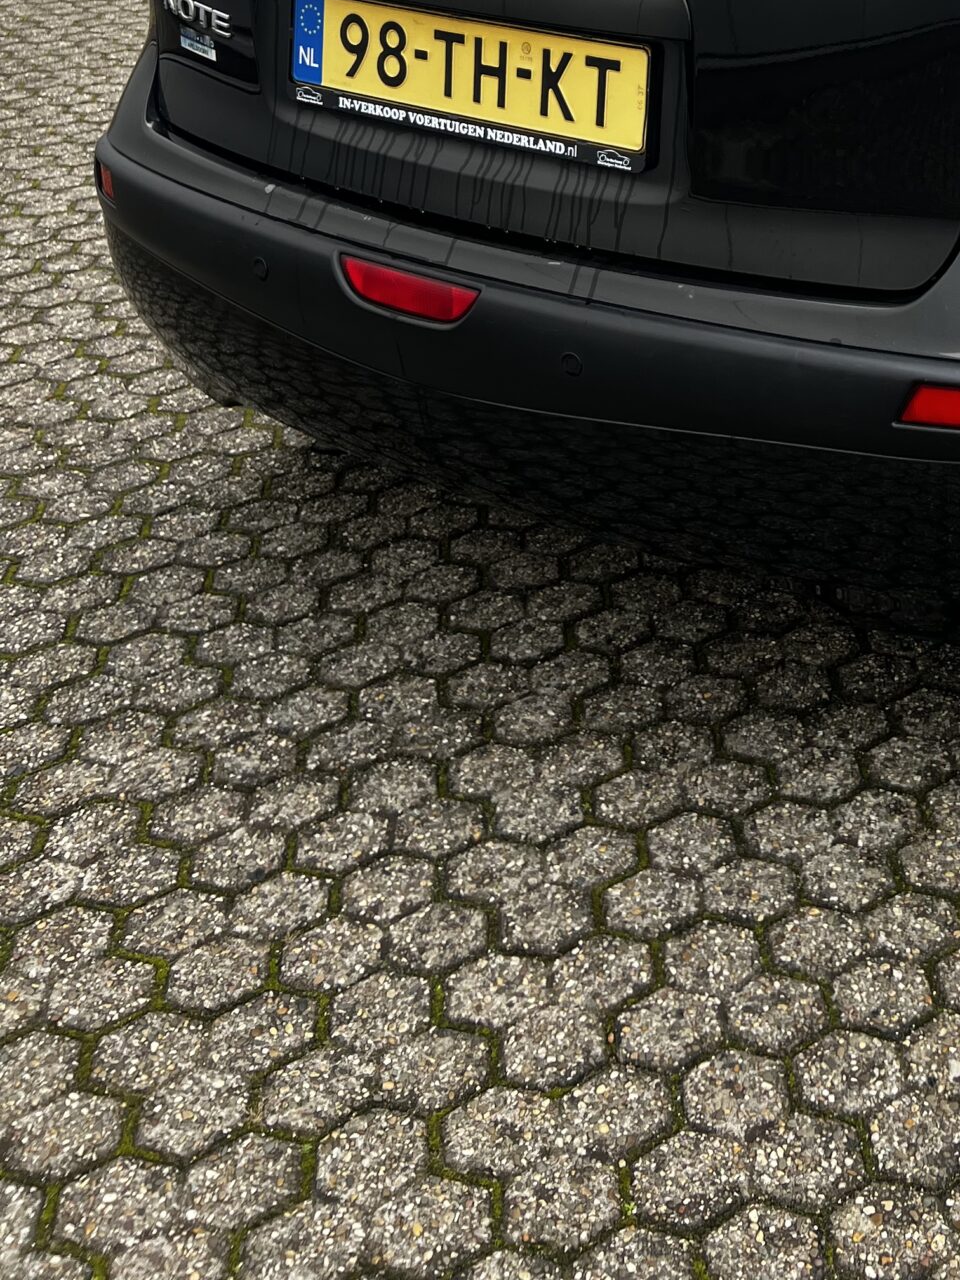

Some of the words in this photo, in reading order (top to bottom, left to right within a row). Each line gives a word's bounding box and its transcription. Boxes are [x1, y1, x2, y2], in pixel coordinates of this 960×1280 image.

[299, 45, 319, 68] NL
[339, 13, 622, 127] 98-TH-KT
[339, 96, 406, 121] IN-VERKOOP
[408, 111, 484, 138] VOERTUIGEN
[487, 127, 577, 158] NEDERLAND.nl
